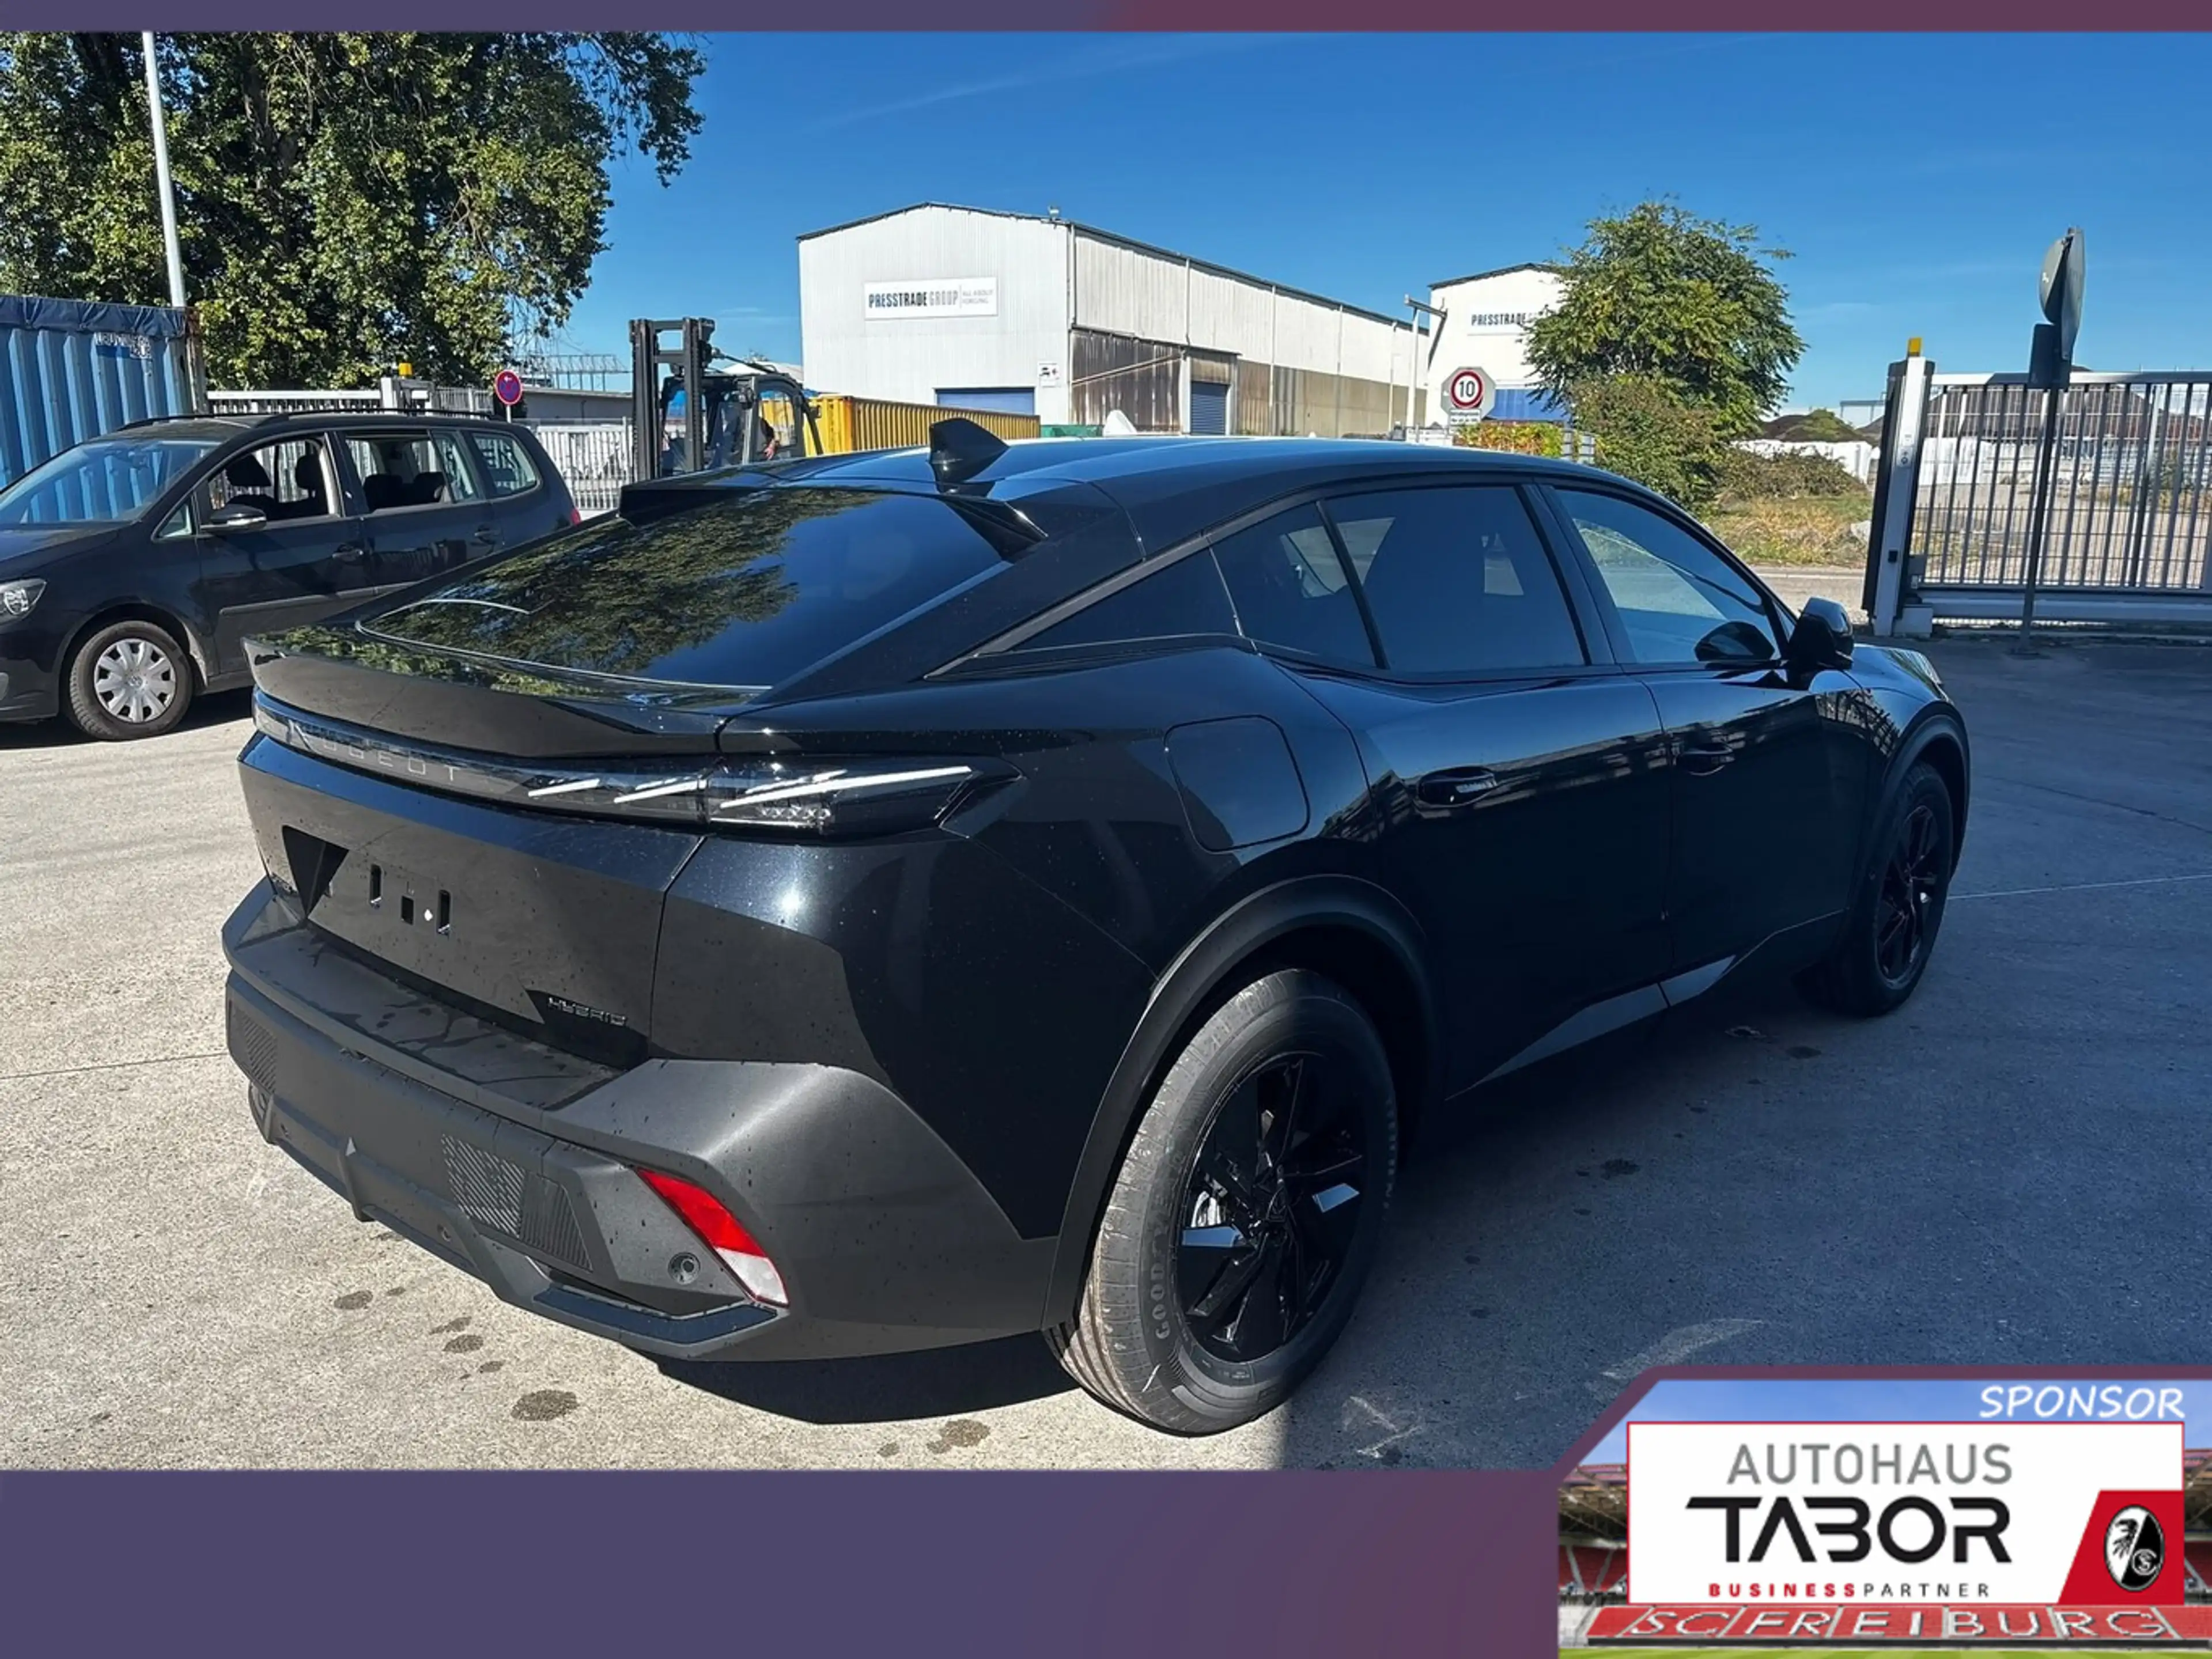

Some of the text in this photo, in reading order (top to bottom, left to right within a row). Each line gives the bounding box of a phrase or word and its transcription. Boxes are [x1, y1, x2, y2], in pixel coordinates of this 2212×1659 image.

[868, 290, 959, 308] PRESSTRADE GROUP
[1471, 313, 1526, 326] PRESSTRADE
[1459, 381, 1476, 397] 10
